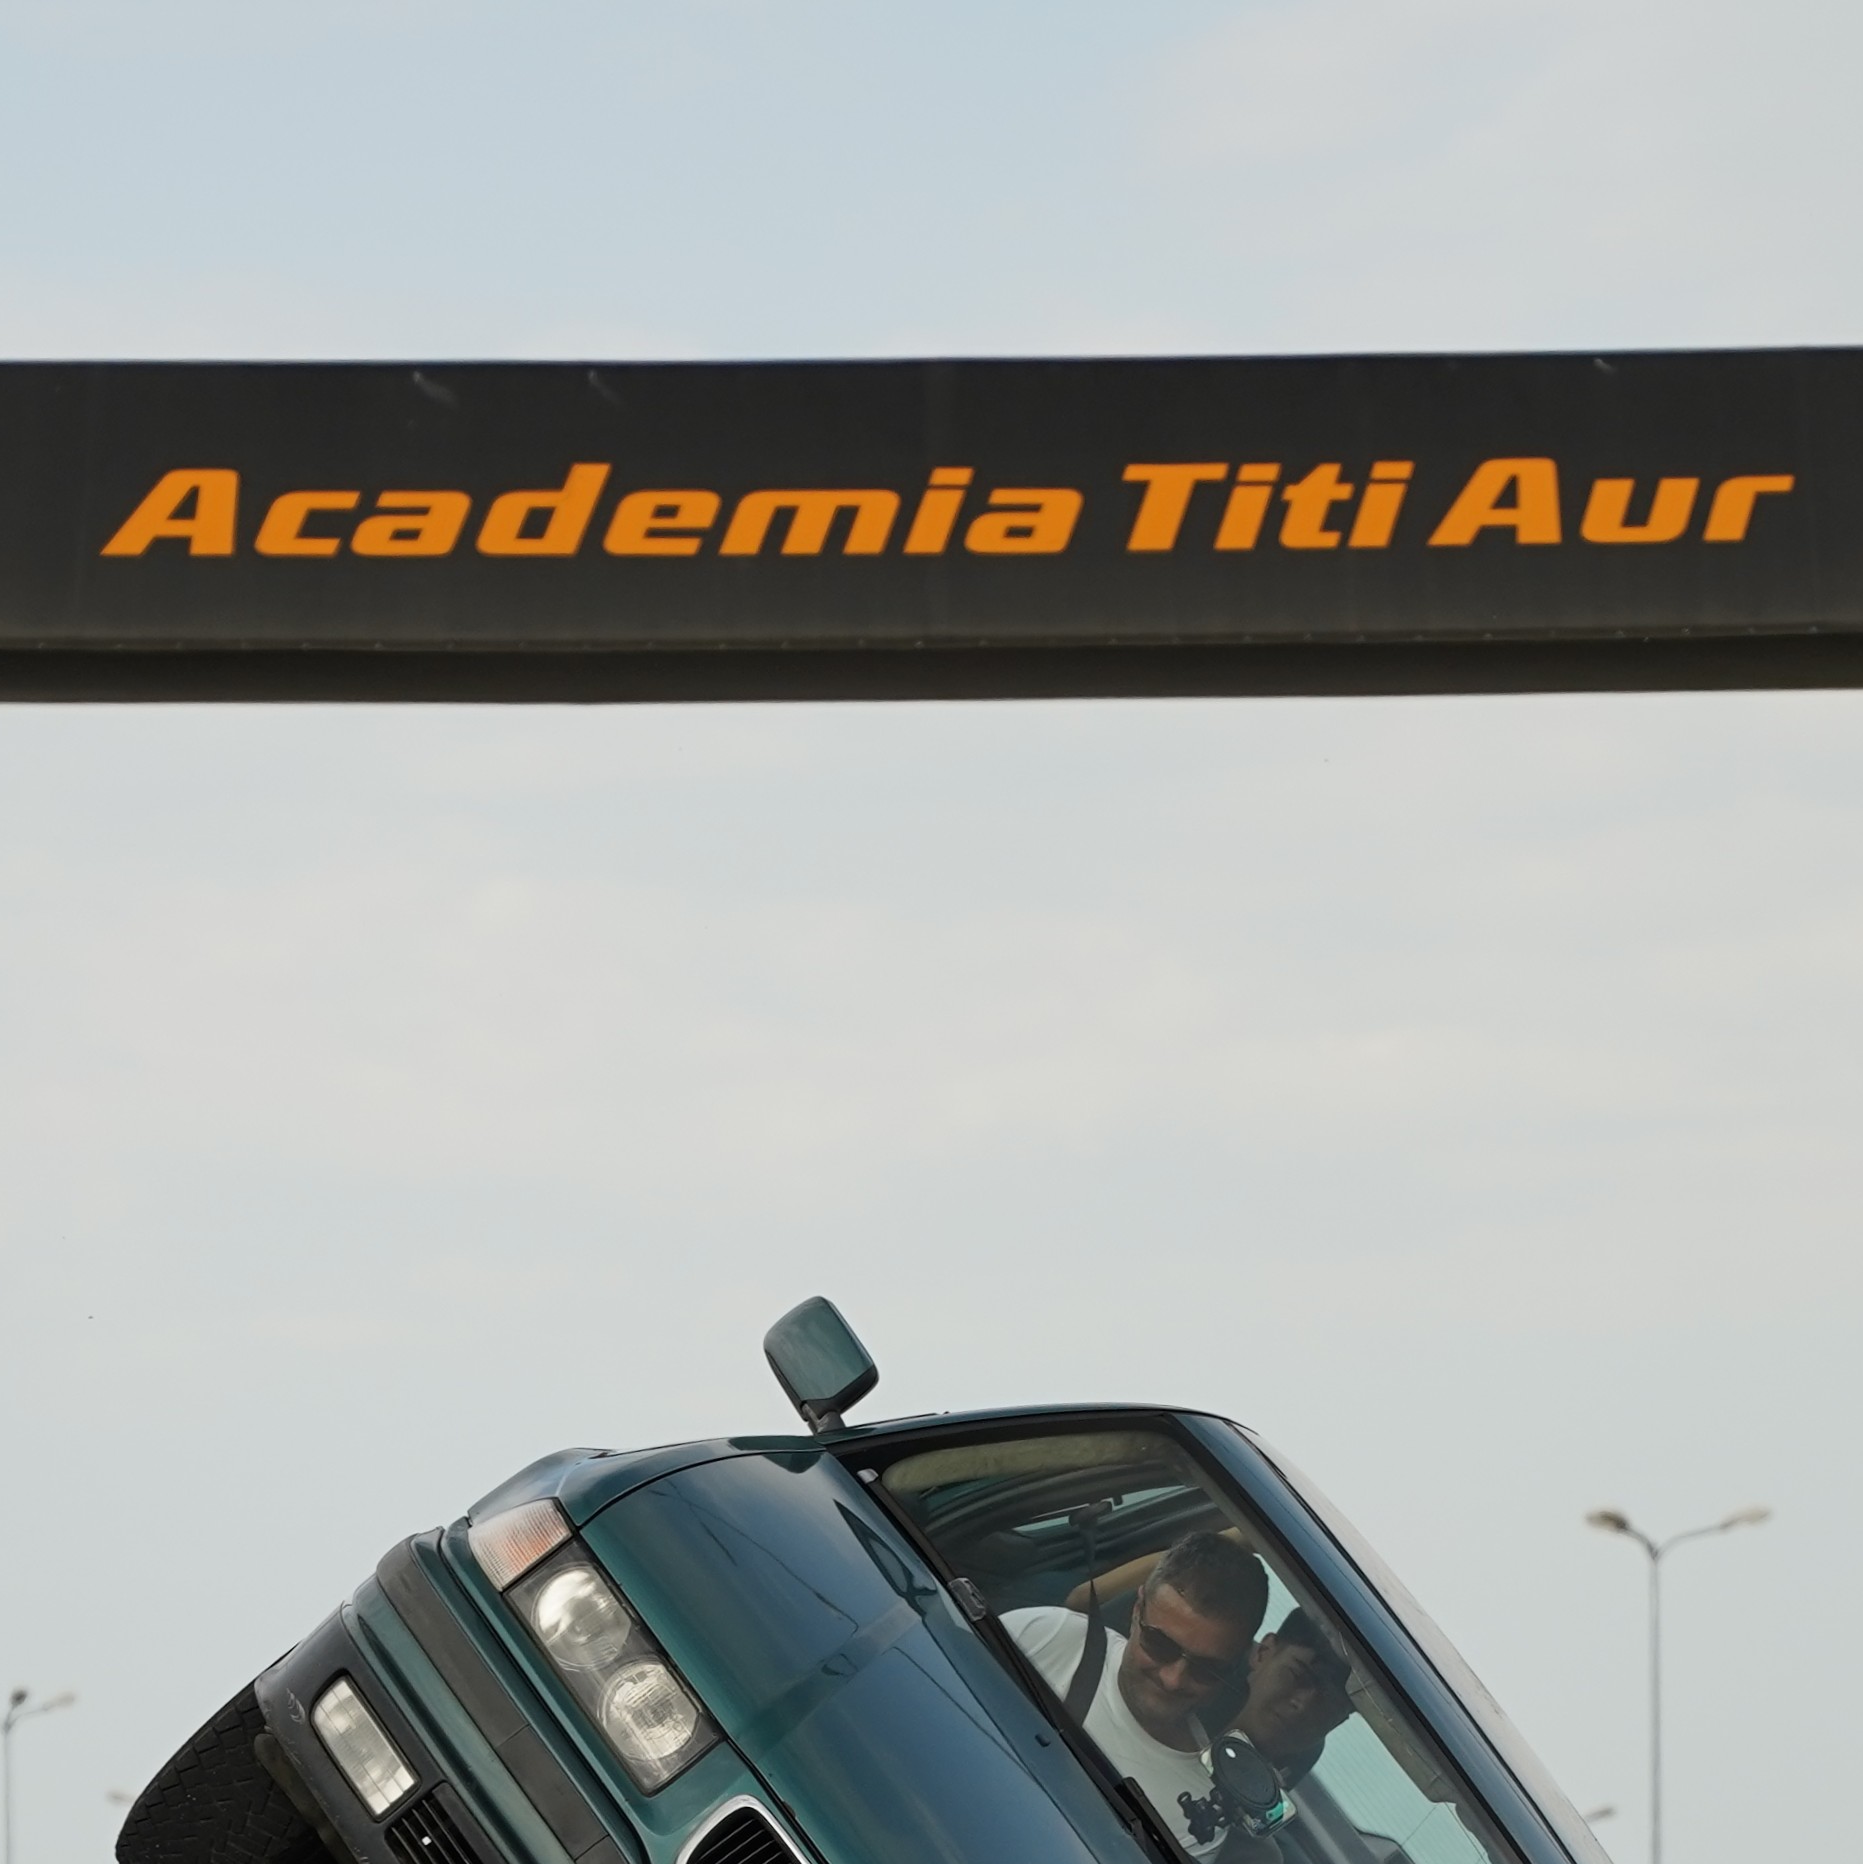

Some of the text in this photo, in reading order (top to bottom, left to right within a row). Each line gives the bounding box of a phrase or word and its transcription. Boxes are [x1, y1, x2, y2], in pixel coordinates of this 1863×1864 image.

[99, 456, 1796, 558] Academia Titi Aur
